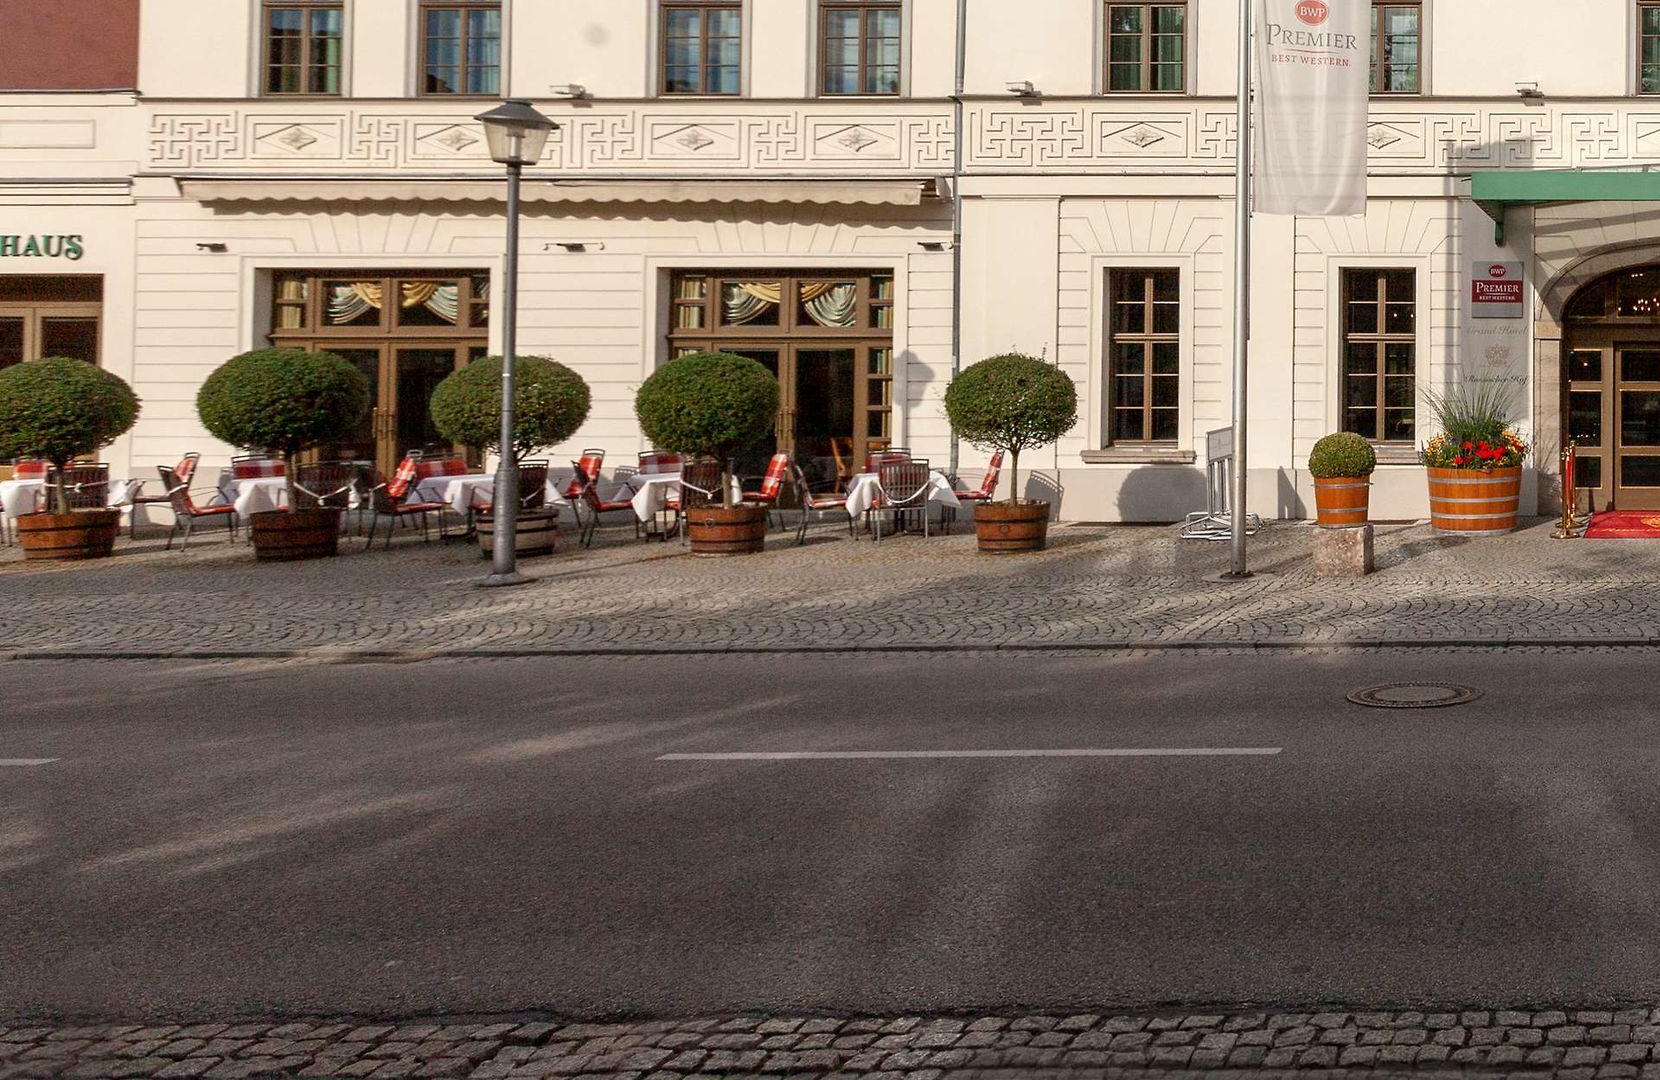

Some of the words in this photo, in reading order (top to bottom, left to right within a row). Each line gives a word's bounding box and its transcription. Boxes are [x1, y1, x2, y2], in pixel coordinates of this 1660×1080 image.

[1300, 6, 1326, 18] BWP
[1266, 23, 1358, 50] PREMIER
[1271, 54, 1297, 63] BEST
[0, 234, 84, 261] HAUS
[1476, 282, 1519, 293] PREMIER
